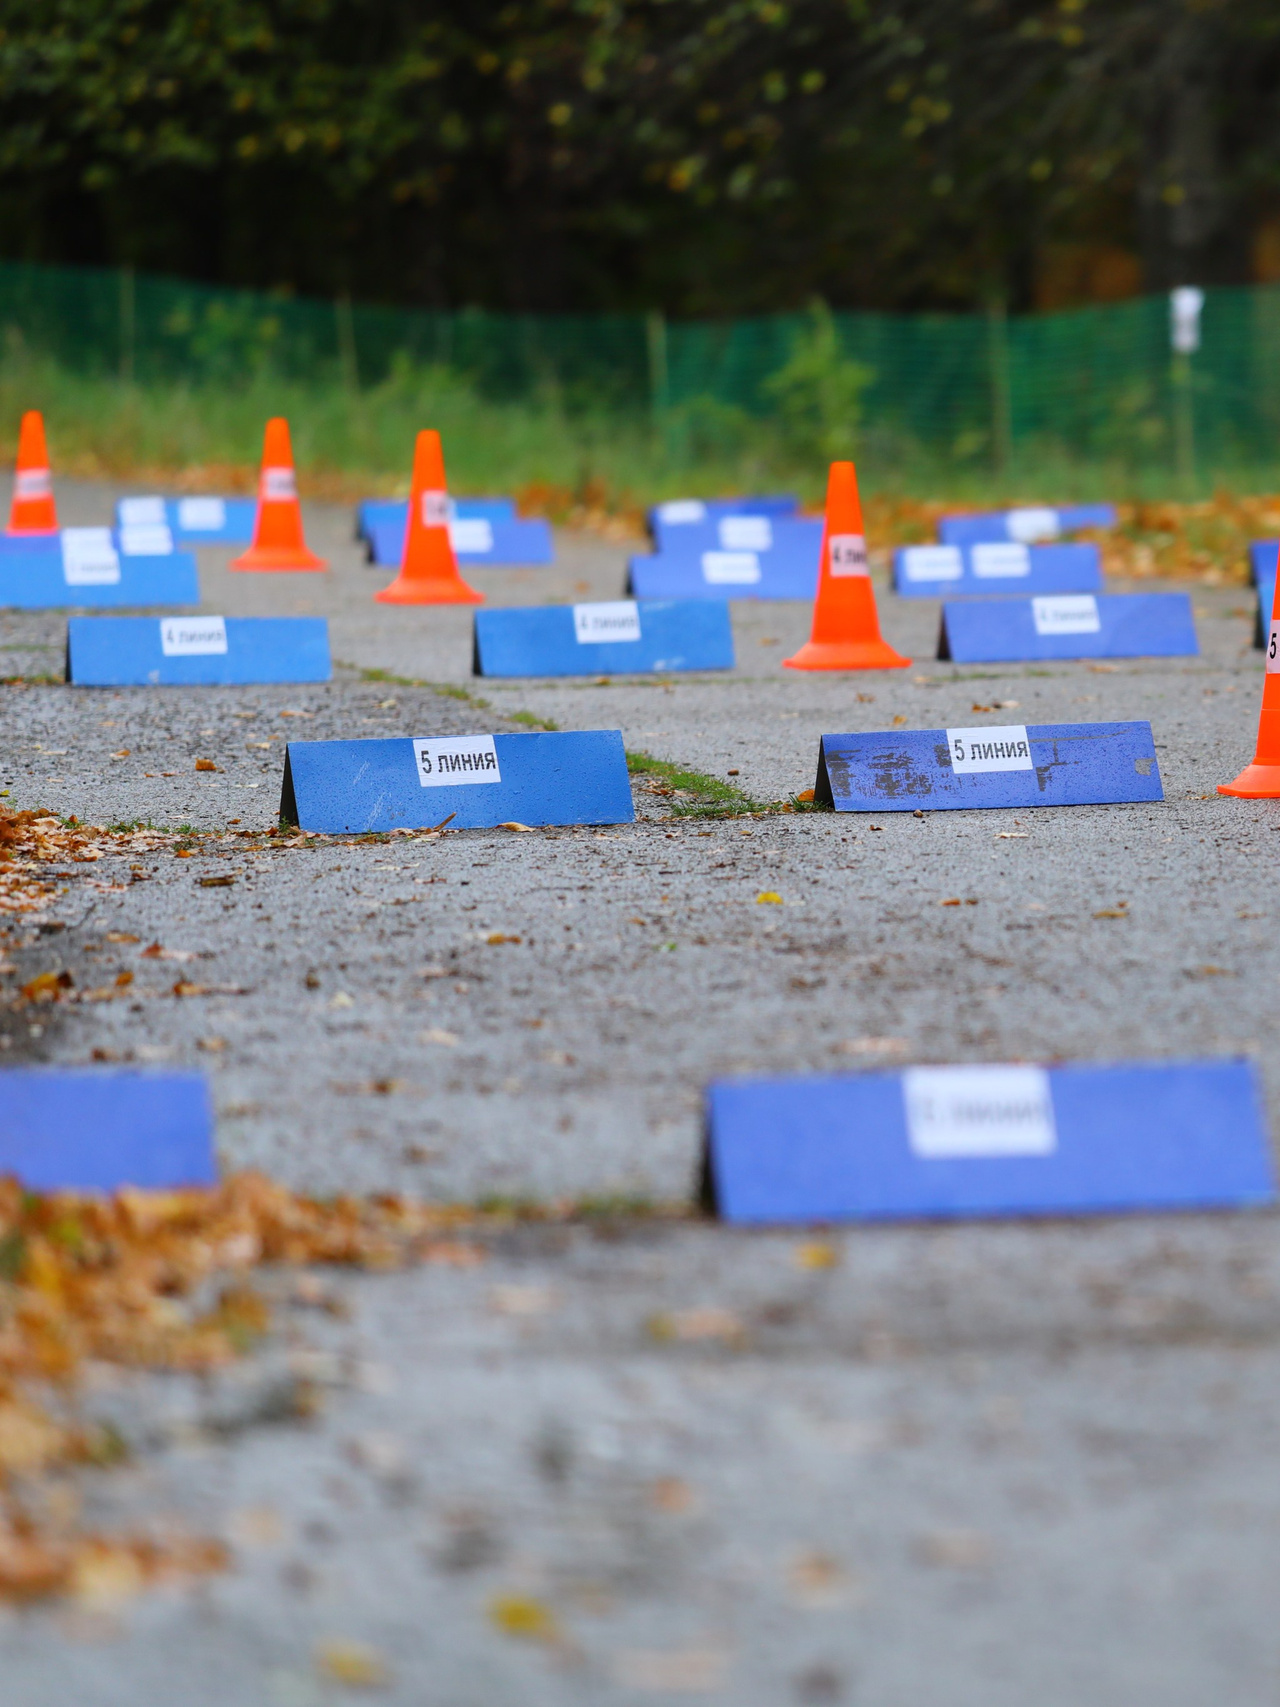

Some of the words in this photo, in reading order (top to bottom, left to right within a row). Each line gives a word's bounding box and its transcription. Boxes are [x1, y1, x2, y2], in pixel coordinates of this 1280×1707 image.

[1269, 632, 1277, 659] 5
[420, 750, 432, 774] 5
[437, 751, 497, 773] линия
[953, 738, 965, 762] 5
[970, 741, 1029, 761] линия
